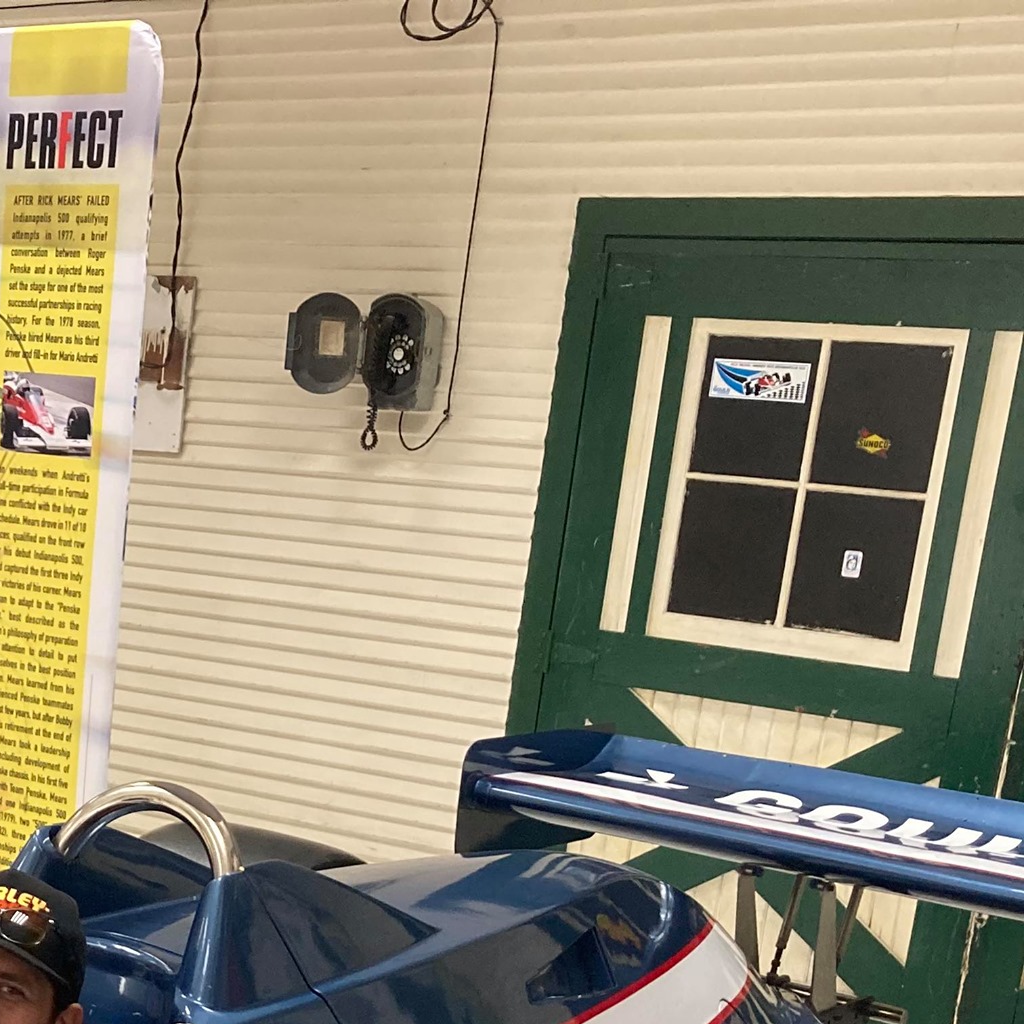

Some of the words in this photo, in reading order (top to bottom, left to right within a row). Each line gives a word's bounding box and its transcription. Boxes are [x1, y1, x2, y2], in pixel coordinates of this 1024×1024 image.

[6, 109, 123, 170] PERFECT
[13, 195, 33, 205] AFTER
[37, 195, 52, 205] RICK
[86, 195, 109, 205] FAILED
[12, 212, 51, 225] Indianapolis
[57, 212, 69, 222] 500
[75, 212, 108, 226] qualifying
[11, 229, 39, 242] attempts
[45, 229, 51, 239] in
[57, 229, 75, 241] 1977,
[81, 232, 85, 240] a
[90, 230, 107, 240] brief
[11, 246, 48, 257] conversation
[55, 247, 80, 257] between
[87, 247, 106, 261] Roger
[9, 263, 30, 273] Penske
[34, 263, 45, 274] and
[49, 266, 52, 274] a
[56, 264, 82, 277] dejected
[85, 265, 104, 275] Mears
[9, 280, 17, 290] set
[18, 280, 28, 290] the
[29, 280, 45, 293] stage
[47, 281, 55, 291] for
[57, 283, 68, 291] one
[69, 282, 75, 292] of
[76, 282, 86, 292] the
[88, 282, 103, 293] most
[8, 297, 38, 307] successful
[38, 298, 75, 312] partnerships
[76, 299, 82, 309] in
[82, 299, 102, 313] racing
[31, 315, 41, 325] For
[45, 315, 54, 325] the
[59, 316, 73, 326] 1978
[77, 319, 100, 329] season,
[28, 331, 43, 342] hired
[45, 332, 63, 343] Mears
[65, 335, 72, 343] as
[73, 333, 83, 344] his
[84, 334, 99, 344] third
[4, 347, 20, 358] driver
[49, 350, 57, 360] for
[58, 350, 74, 361] Mario
[858, 438, 890, 449] SUNOCO
[3, 545, 12, 555] his
[15, 547, 31, 558] debut
[33, 549, 68, 565] Indianapolis
[71, 553, 84, 566] 500,
[4, 562, 28, 576] captured
[29, 565, 38, 575] the
[40, 566, 52, 577] first
[53, 568, 68, 579] three
[69, 570, 82, 583] Indy
[8, 610, 21, 621] best
[25, 613, 54, 626] described
[58, 619, 65, 628] as
[69, 619, 79, 630] the
[1, 641, 25, 654] attention
[28, 645, 34, 655] to
[38, 647, 54, 658] detail
[57, 650, 63, 660] to
[67, 651, 77, 664] put
[19, 660, 25, 670] in
[27, 661, 36, 671] the
[38, 663, 51, 674] best
[53, 665, 75, 680] position
[6, 674, 24, 685] Mears
[26, 677, 47, 689] learned
[49, 681, 63, 692] from
[65, 683, 74, 694] his
[0, 735, 16, 746] Mears
[19, 738, 31, 749] took
[34, 743, 37, 751] a
[40, 742, 70, 759] leadership
[24, 755, 60, 773] development
[63, 762, 69, 772] of
[10, 783, 24, 795] Team
[25, 786, 47, 801] Penske,
[49, 791, 67, 803] Mears
